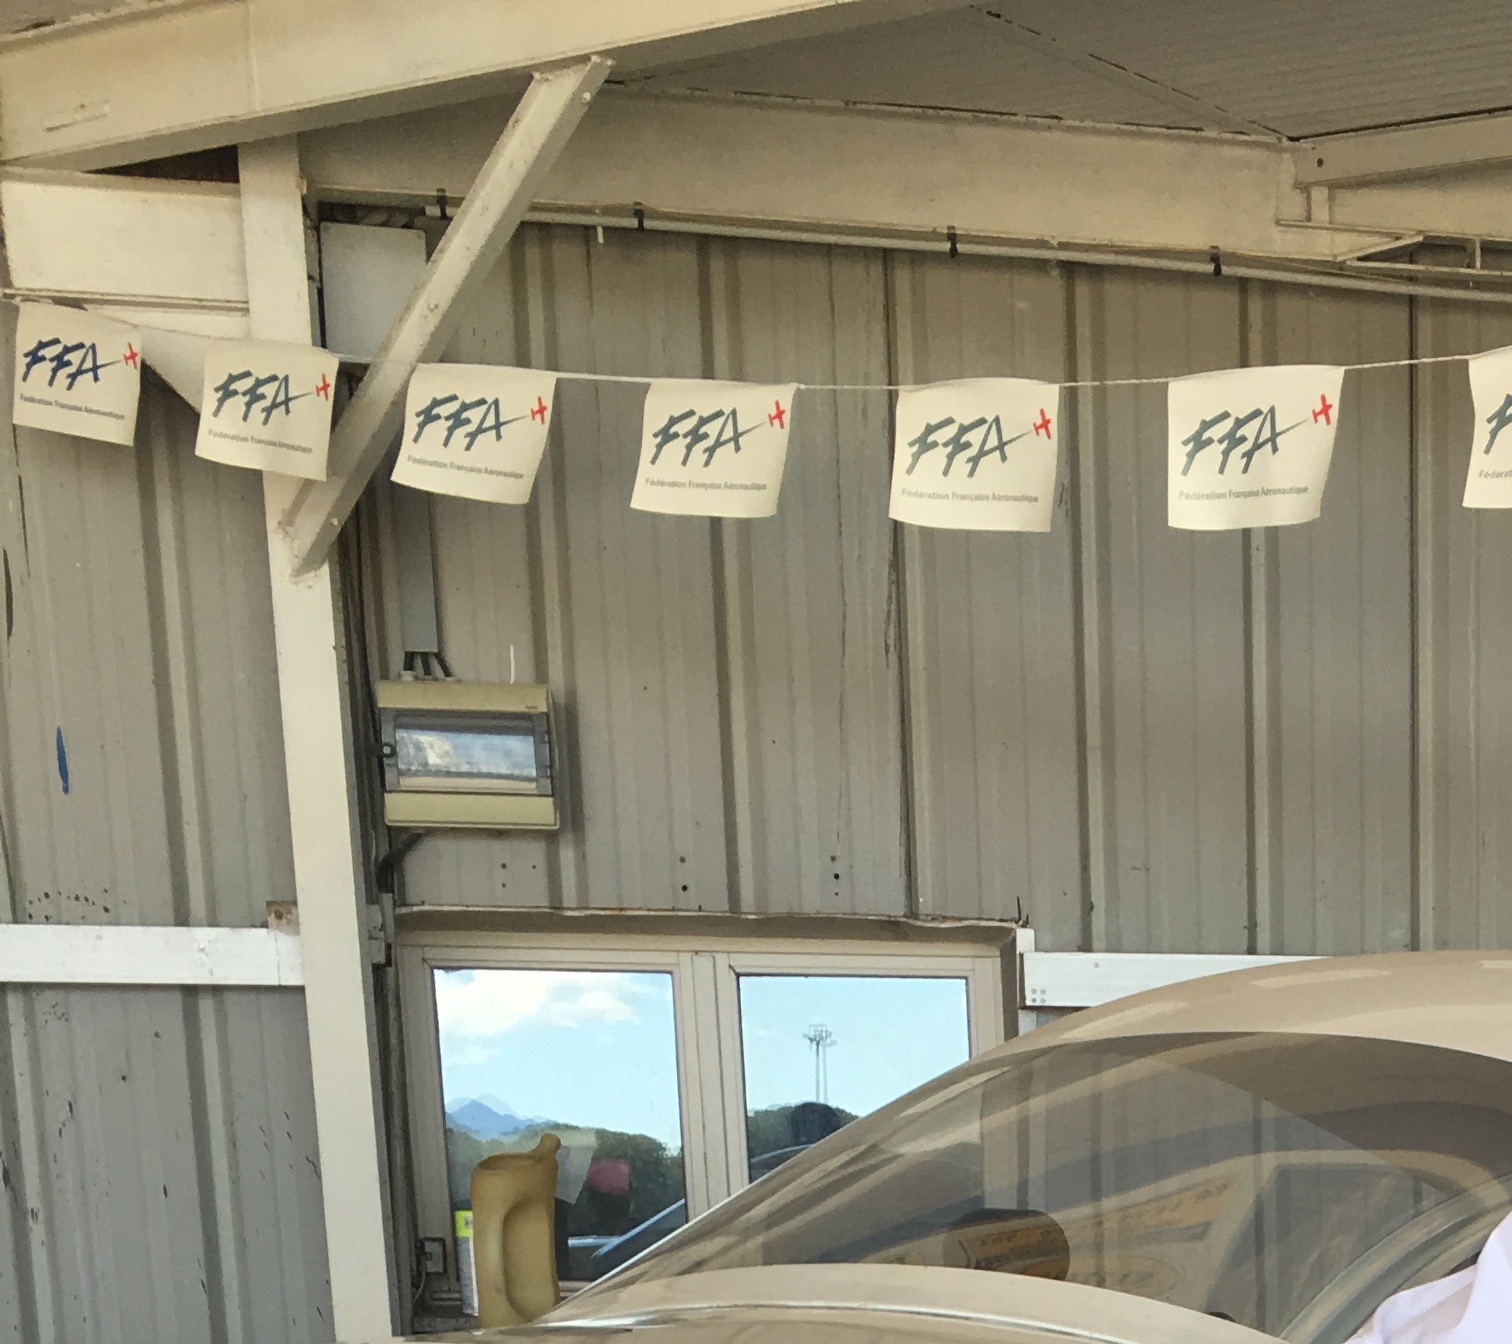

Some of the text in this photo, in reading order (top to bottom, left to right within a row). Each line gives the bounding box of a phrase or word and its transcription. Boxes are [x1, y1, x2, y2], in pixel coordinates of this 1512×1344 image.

[22, 337, 121, 391] FFA
[212, 370, 314, 426] FFA
[412, 394, 529, 451] FFA
[650, 407, 767, 468] FFA
[905, 414, 1032, 479] FFA
[1181, 404, 1309, 477] FFA
